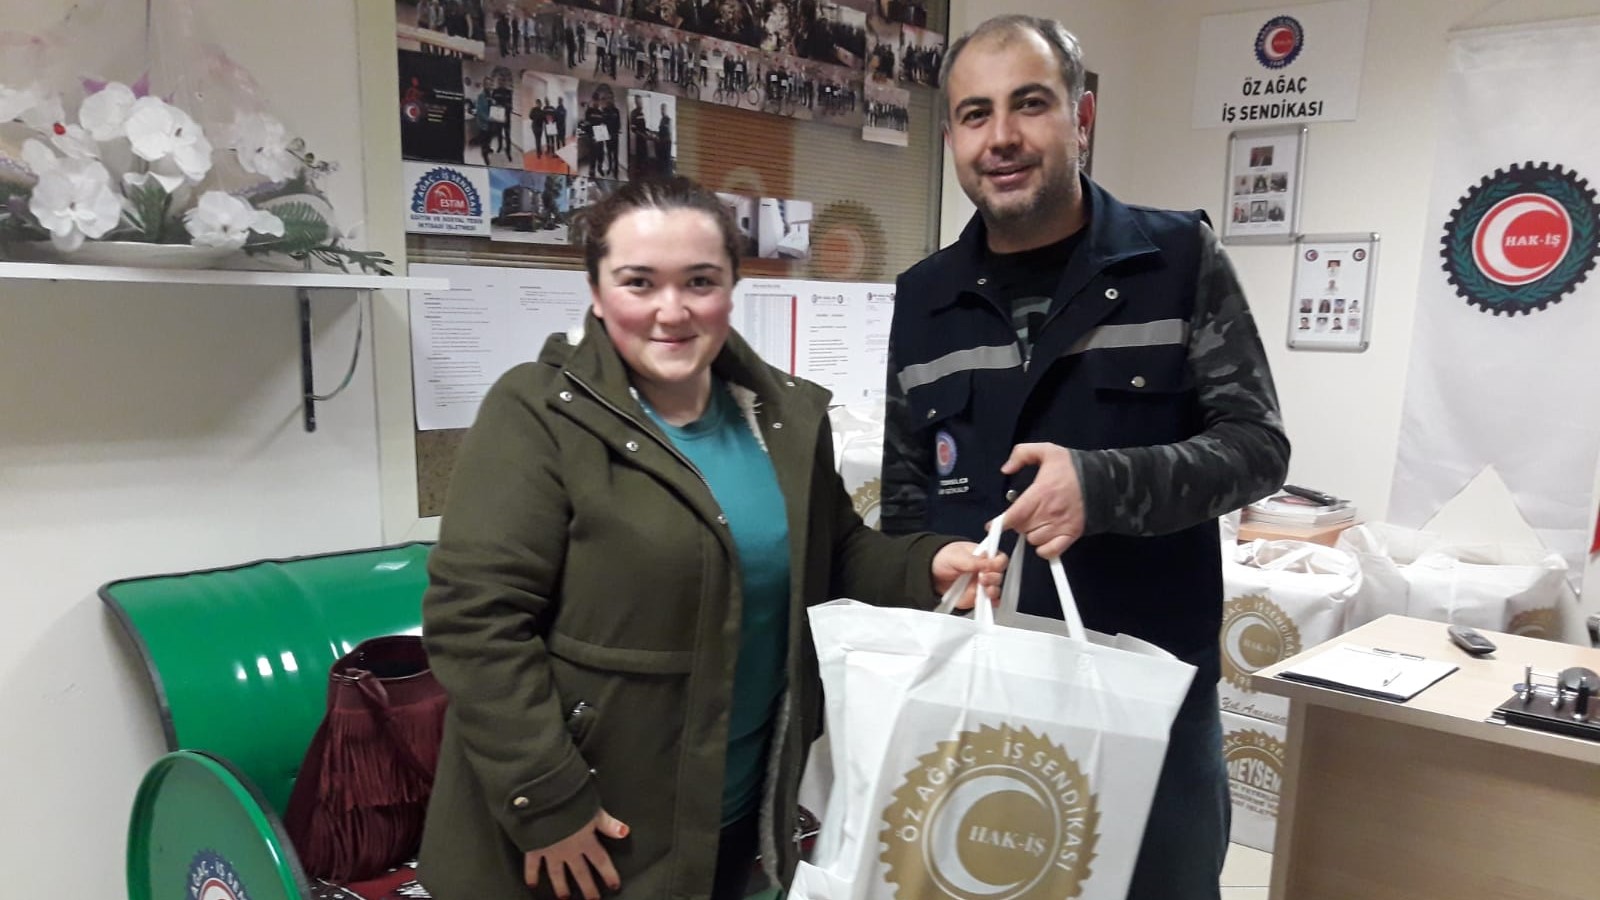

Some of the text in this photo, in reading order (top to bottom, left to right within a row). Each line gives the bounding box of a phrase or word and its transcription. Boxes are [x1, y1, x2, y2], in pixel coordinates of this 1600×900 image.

[1242, 75, 1308, 96] ÖZ AĞAÇ
[1222, 99, 1323, 123] İŞ SENDİKASI
[1504, 233, 1561, 248] HAK-İŞ
[896, 806, 922, 842] ÖZ
[916, 745, 977, 802] AĞAÇ
[1002, 735, 1025, 765] İŞ
[1029, 750, 1087, 871] SENDİKASI
[968, 824, 1048, 859] HAK-İŞ
